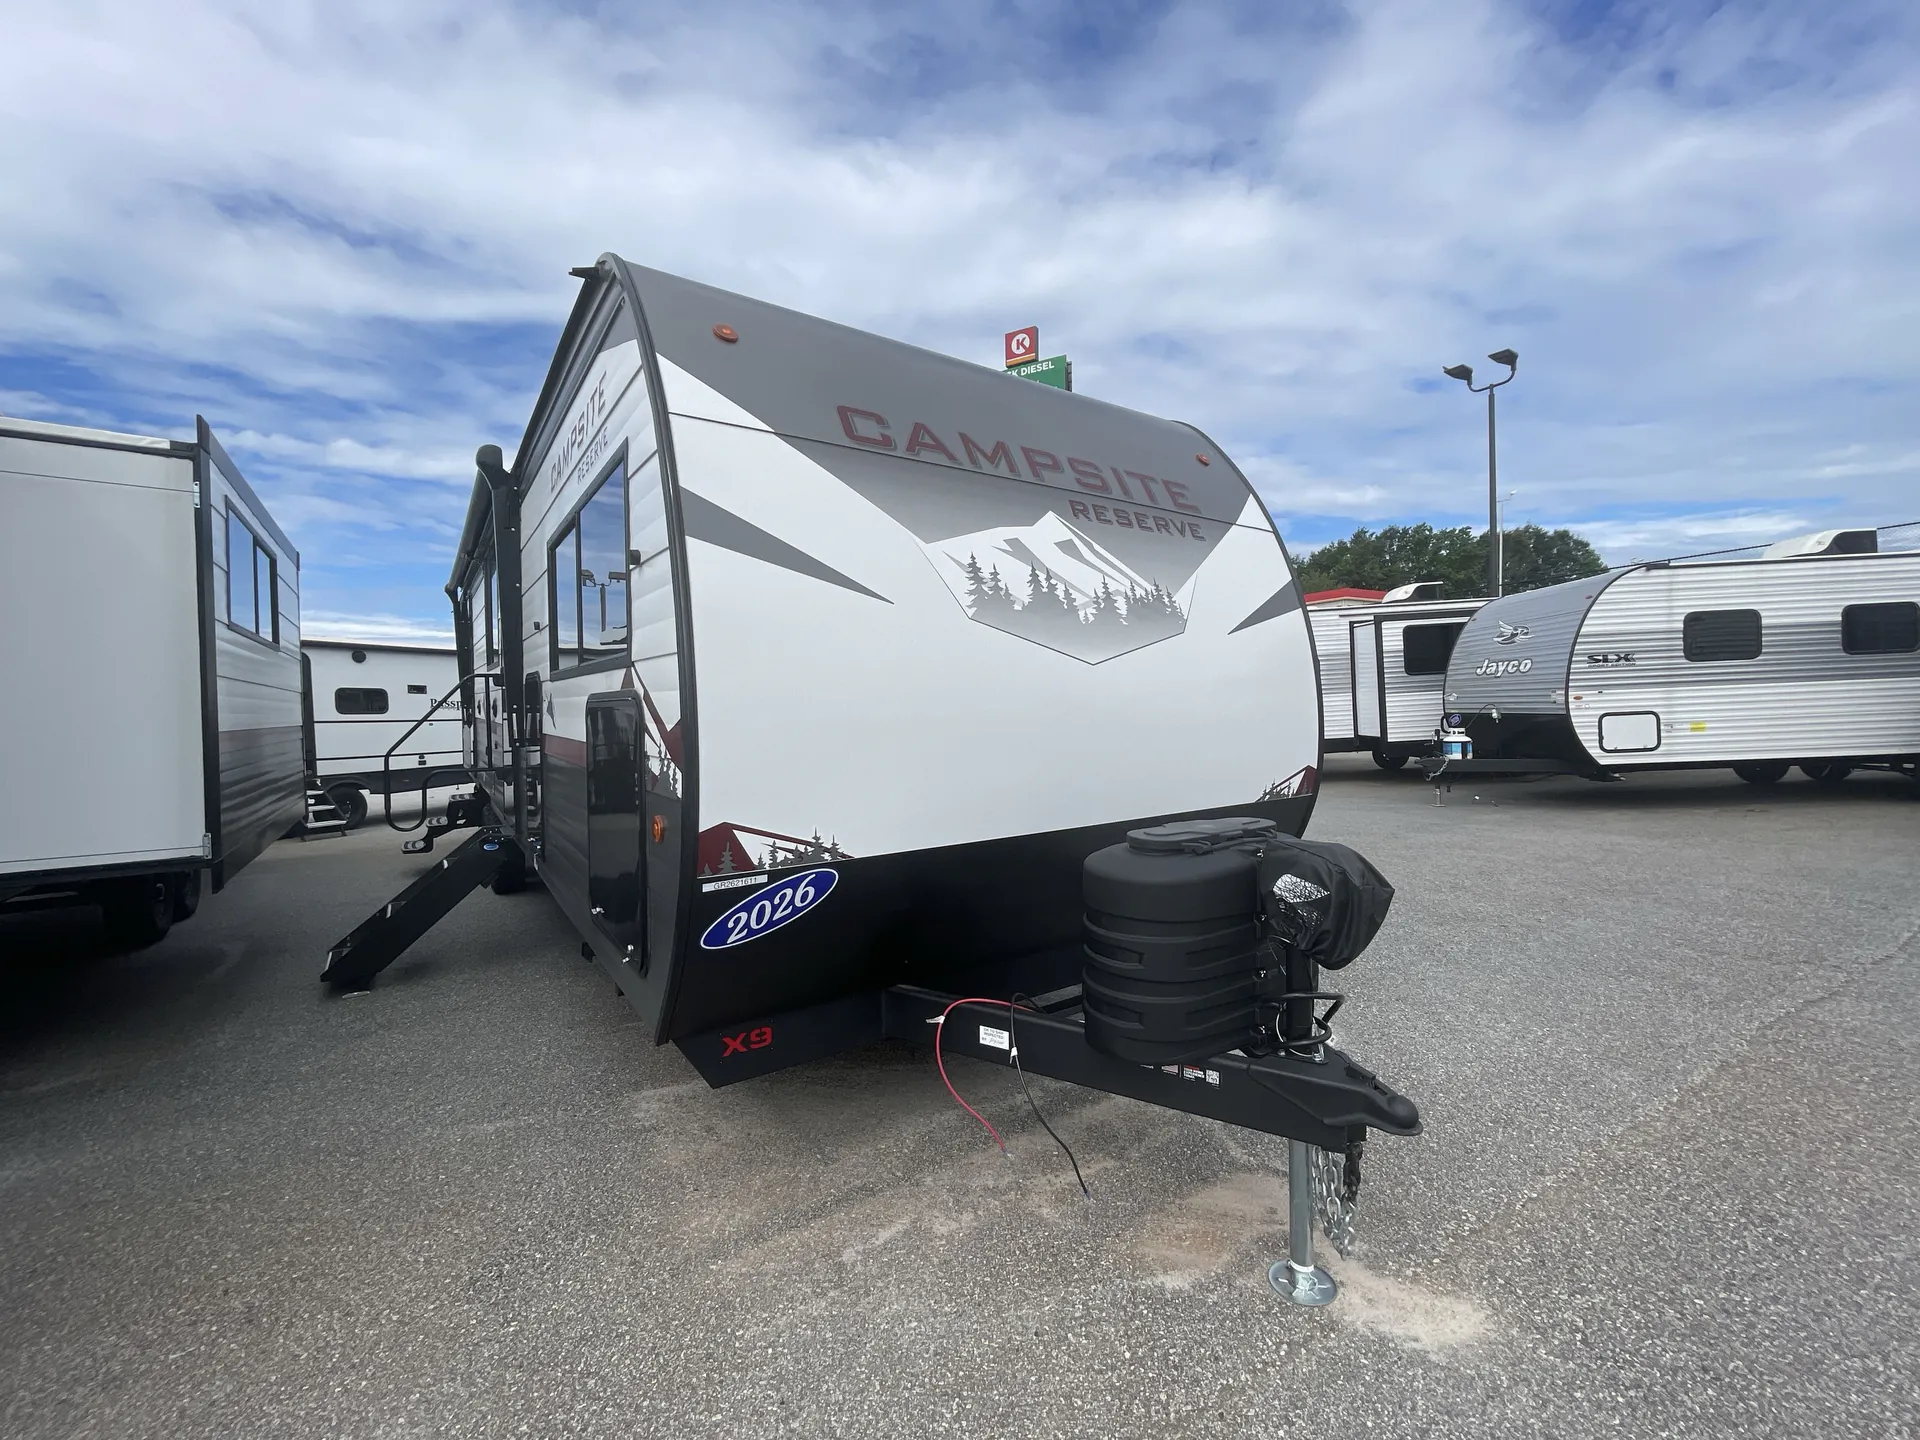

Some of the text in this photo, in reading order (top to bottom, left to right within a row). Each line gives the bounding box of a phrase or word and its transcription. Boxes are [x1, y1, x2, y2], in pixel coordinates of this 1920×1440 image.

[1014, 335, 1029, 352] K
[1020, 361, 1055, 376] DIESEL
[551, 370, 607, 492] CAMPSITE
[577, 426, 608, 485] RESERVE
[836, 405, 1203, 515] CAMPSITE
[1068, 499, 1206, 542] RESERVE
[1475, 659, 1533, 677] Jayco
[1587, 653, 1636, 664] SLX
[713, 877, 758, 890] GR2621611
[727, 874, 816, 944] 2026
[722, 1026, 773, 1057] X9
